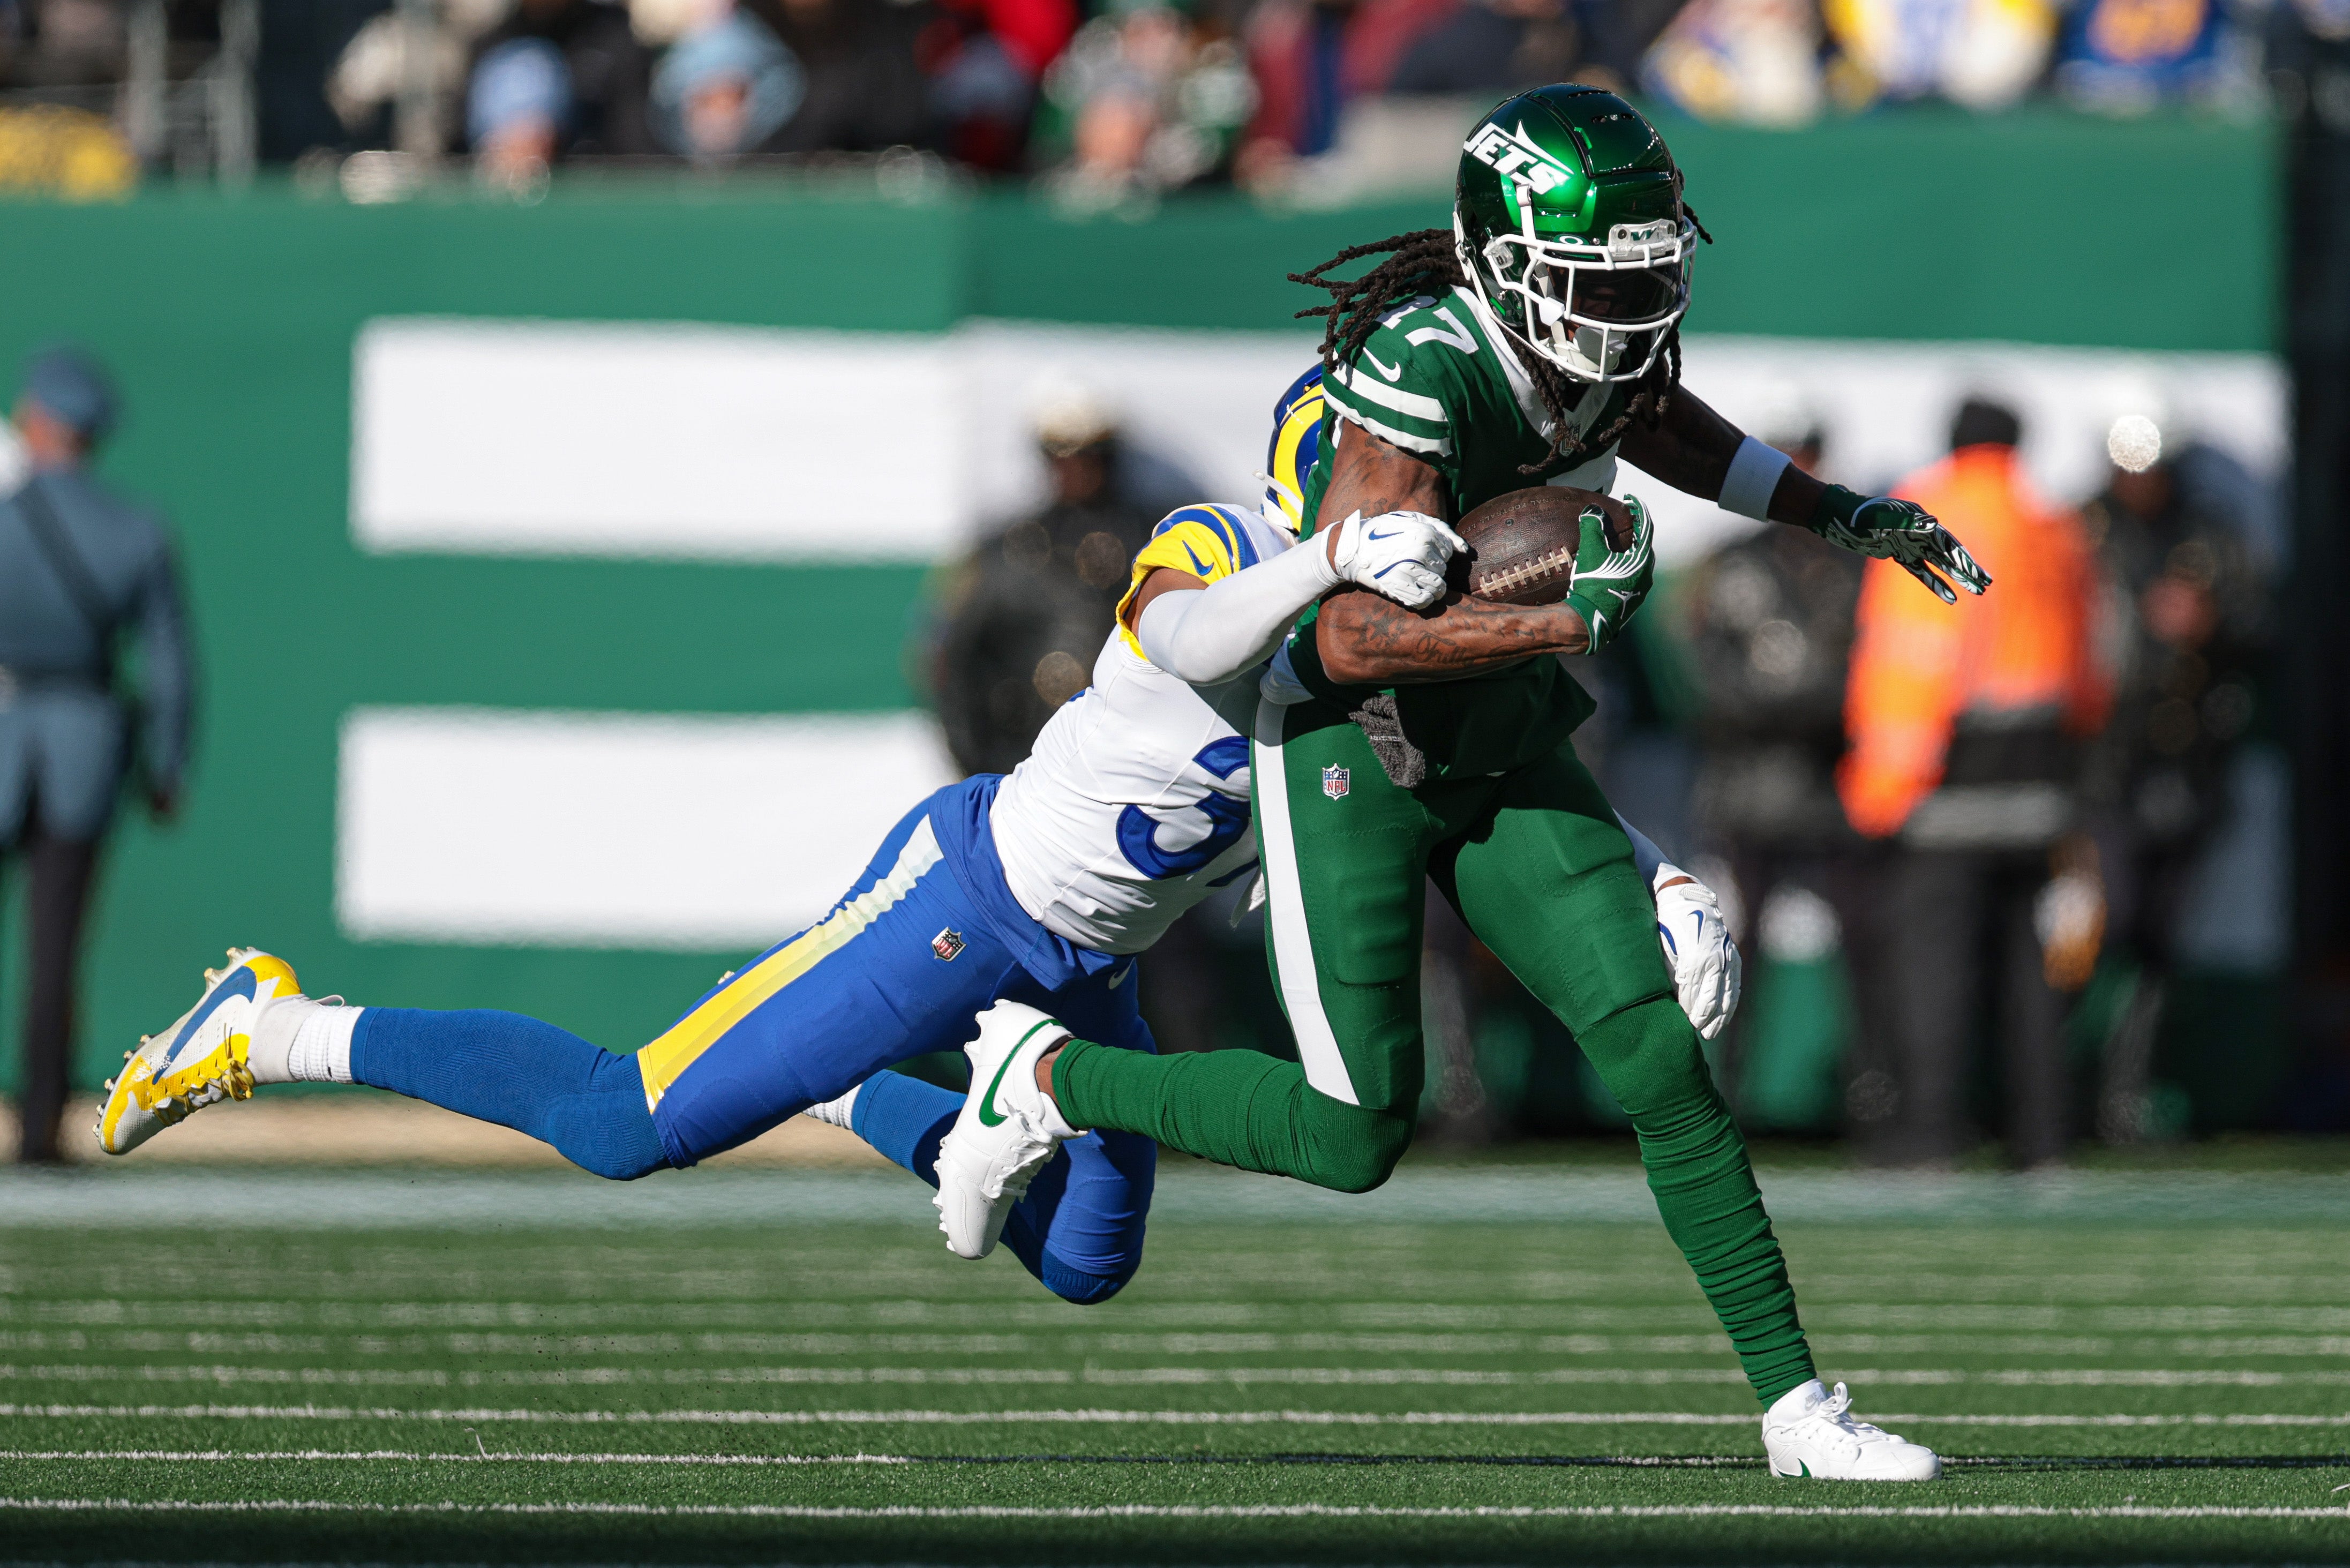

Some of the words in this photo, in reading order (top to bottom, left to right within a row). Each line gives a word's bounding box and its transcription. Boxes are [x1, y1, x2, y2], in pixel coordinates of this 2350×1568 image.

[1463, 120, 1572, 195] JETS
[1459, 523, 1476, 537] LEA
[1327, 780, 1346, 793] NFL
[934, 937, 954, 958] NFL
